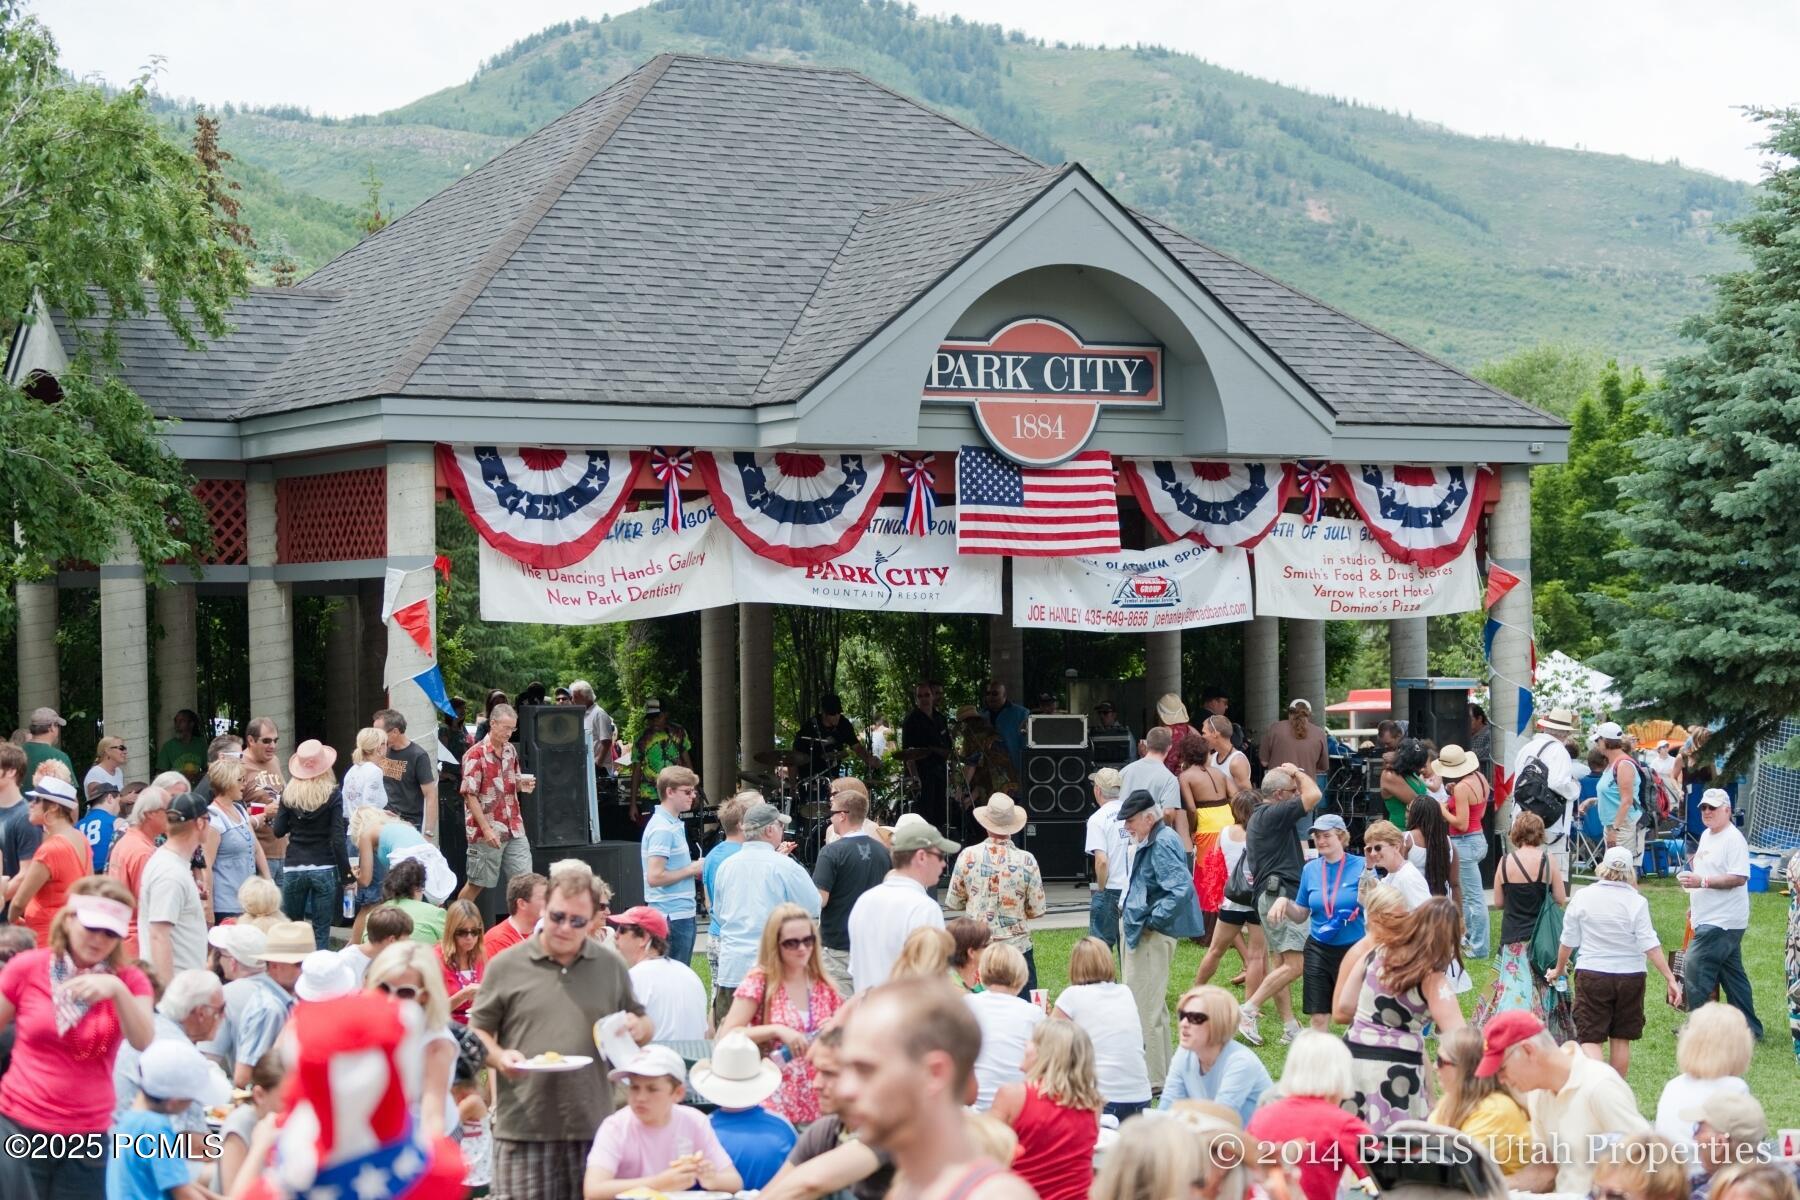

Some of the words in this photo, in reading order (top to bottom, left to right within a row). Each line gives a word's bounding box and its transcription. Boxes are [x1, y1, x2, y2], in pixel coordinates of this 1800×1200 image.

[926, 353, 1034, 391] PARK
[1043, 355, 1143, 393] CITY
[1012, 413, 1066, 440] 1884
[606, 522, 643, 541] LVER
[652, 506, 717, 535] SPSOR
[1302, 524, 1318, 540] OF
[1324, 525, 1351, 541] JULY
[1175, 544, 1210, 563] SPON
[1323, 555, 1334, 564] in
[1340, 554, 1376, 565] studio
[548, 568, 605, 587] Dancing
[611, 559, 663, 583] Hands
[668, 551, 705, 571] Gallery
[805, 561, 877, 585] PARK
[886, 566, 949, 587] CITY
[1283, 565, 1328, 581] Smith's
[1335, 568, 1363, 581] Food
[1369, 569, 1382, 581] &
[1388, 567, 1414, 583] Drug
[1418, 567, 1453, 580] Stores
[547, 588, 580, 606] New
[586, 589, 622, 606] Park
[628, 582, 683, 602] Dentistry
[812, 588, 884, 599] MOUNTAIN
[898, 591, 940, 601] RESORT
[1313, 584, 1353, 598] Yarrow
[1360, 586, 1398, 599] Resort
[1403, 583, 1434, 597] Hotel
[1028, 604, 1045, 621] JOE
[1050, 606, 1082, 624] HANLEY
[1085, 610, 1148, 626] 435-649-8656
[1331, 599, 1387, 613] Domino's
[1392, 600, 1421, 612] Pizza
